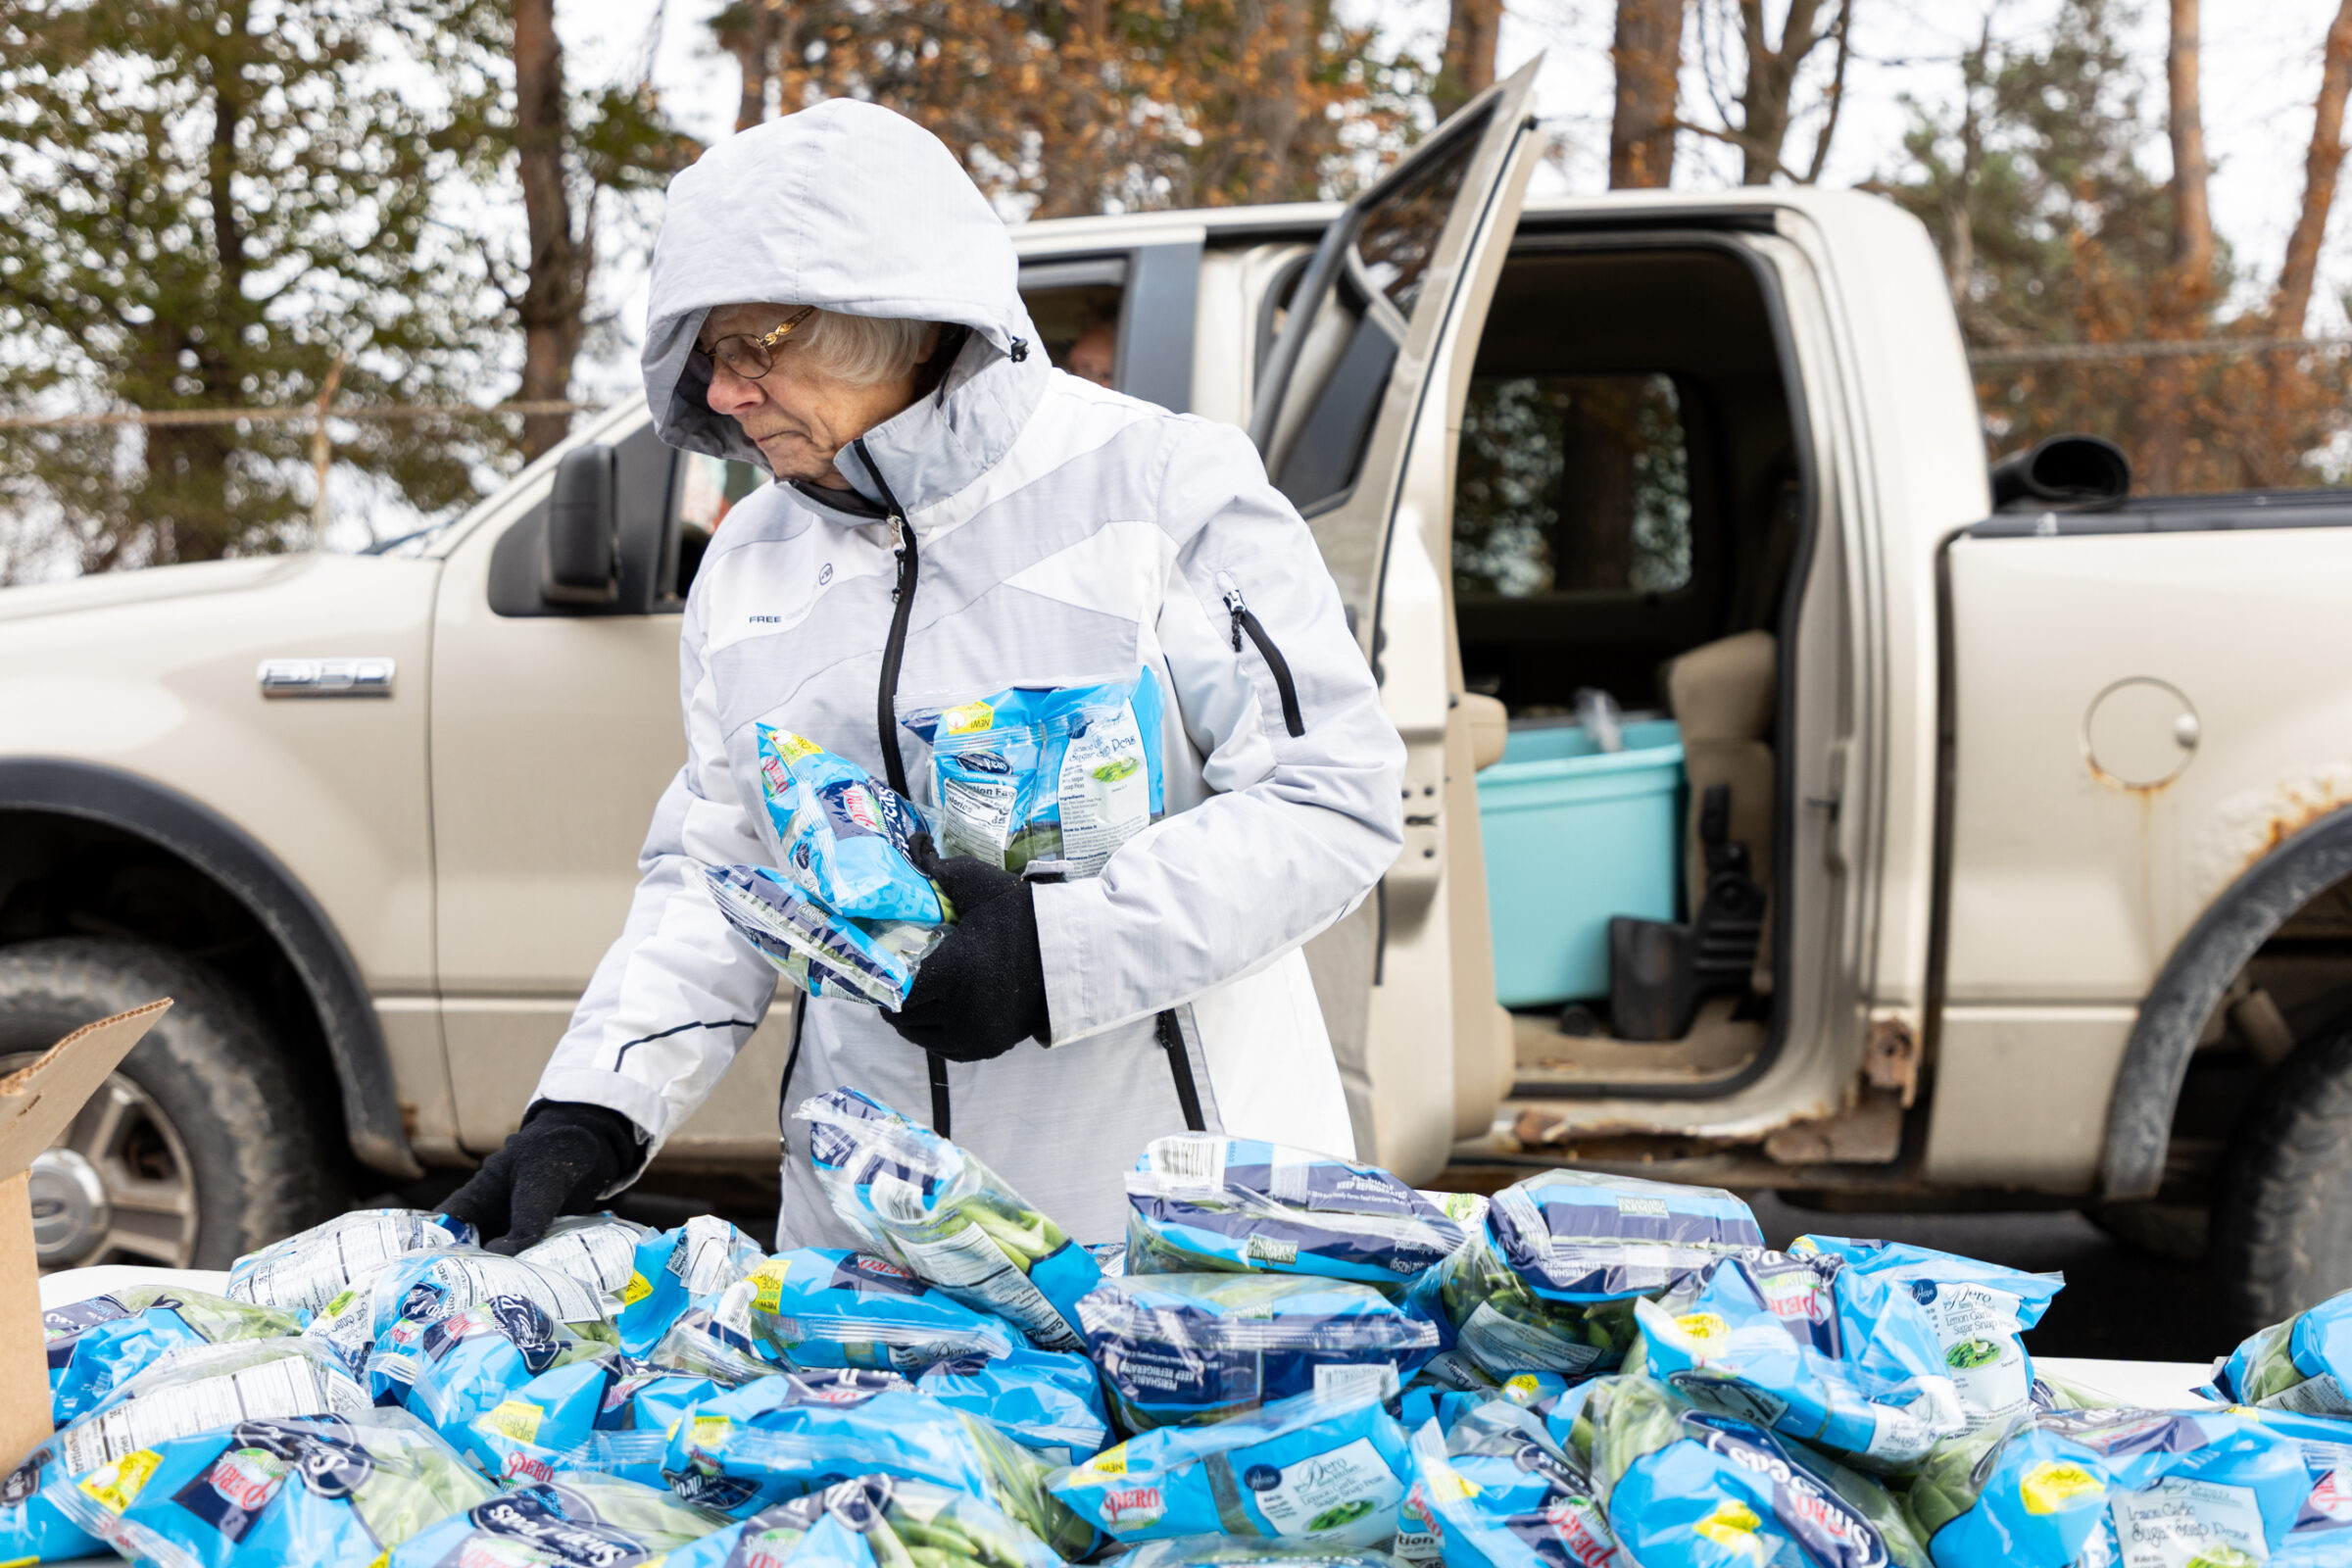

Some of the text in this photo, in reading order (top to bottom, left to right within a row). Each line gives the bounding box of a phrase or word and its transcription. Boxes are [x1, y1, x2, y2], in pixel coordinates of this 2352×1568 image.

[1131, 1374, 1178, 1392] PERISHABLE
[1175, 1370, 1195, 1383] KEEP
[501, 1451, 554, 1483] PERO
[209, 1463, 283, 1511] PERO
[1103, 1487, 1159, 1526] PERO
